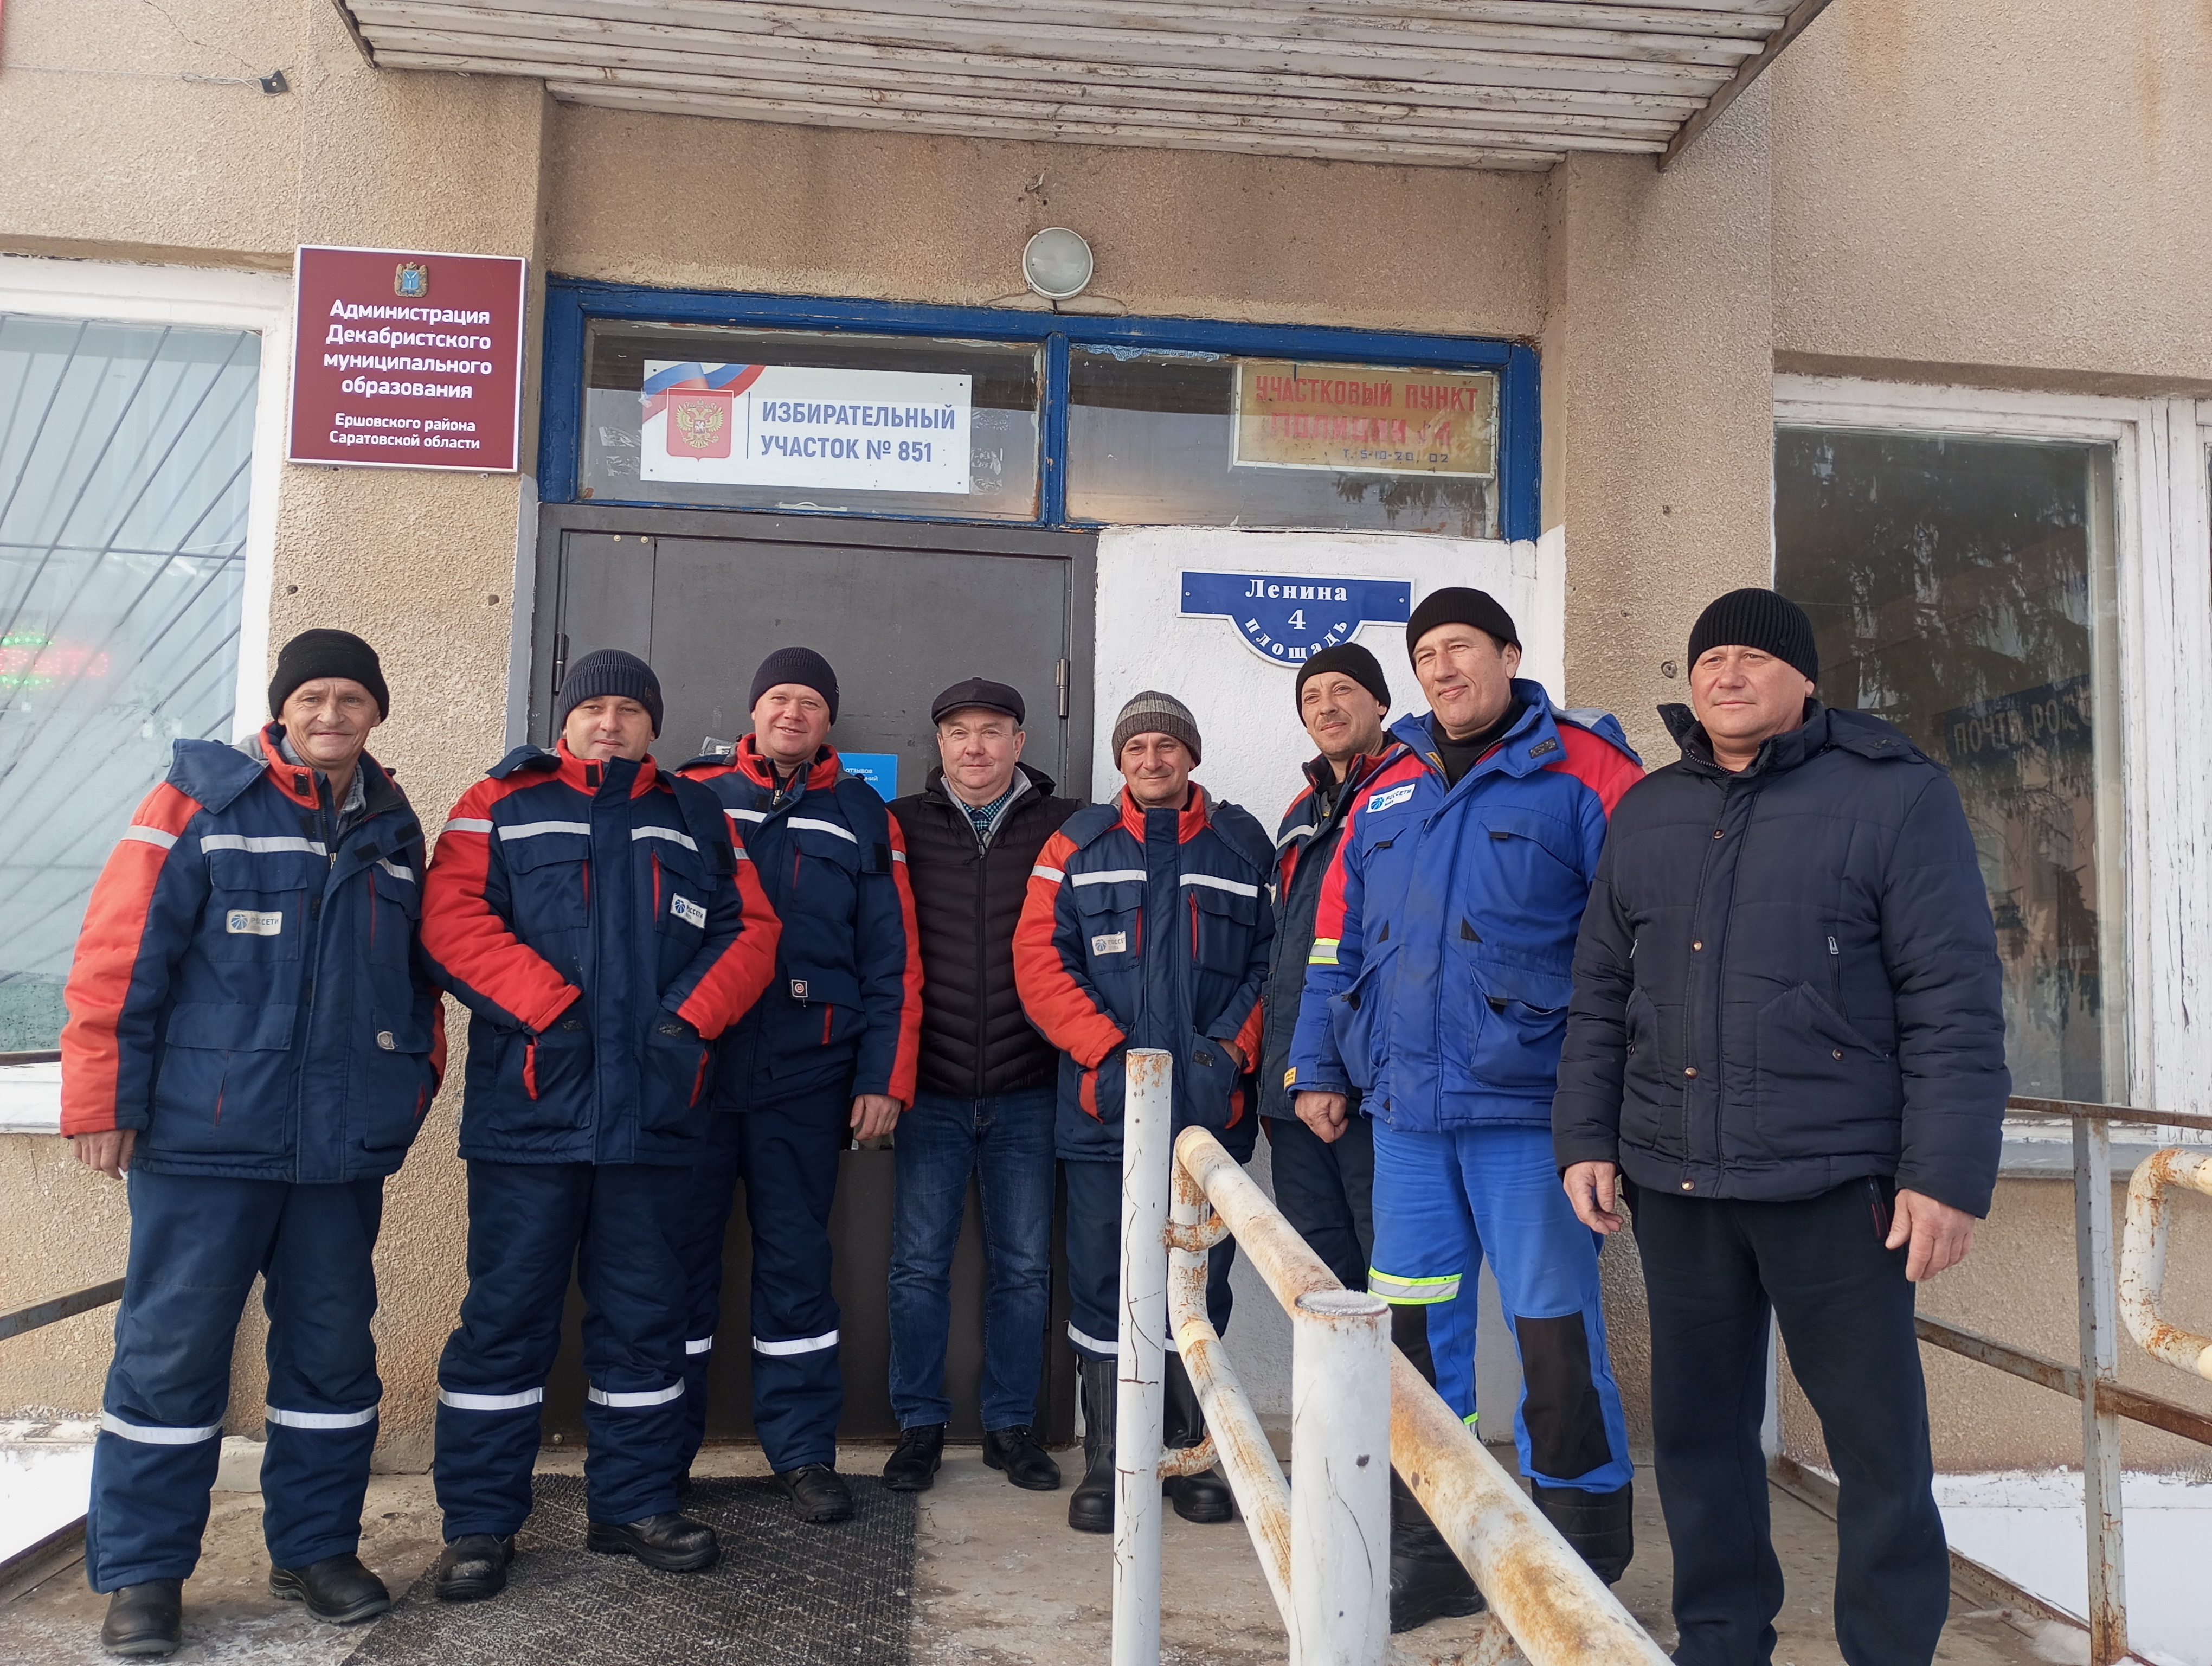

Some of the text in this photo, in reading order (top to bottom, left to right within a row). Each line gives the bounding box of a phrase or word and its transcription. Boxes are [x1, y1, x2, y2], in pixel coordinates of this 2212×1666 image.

[330, 299, 490, 325] Администрация
[326, 324, 491, 349] Декабристского
[324, 354, 492, 374] муниципального
[342, 376, 473, 399] образования
[1256, 375, 1478, 411] УЧАСТКОВЫЙ ПУНКТ
[335, 413, 475, 432] Ершовского района
[763, 402, 955, 430] ИЗБИРАТЕЛЬНЫЙ
[1271, 412, 1406, 443] ПОЛИЦИИ
[329, 431, 480, 450] Саратовской области
[761, 435, 931, 462] УЧАСТОК № 851
[1245, 579, 1348, 602] Ленина
[1288, 609, 1306, 630] 4
[1245, 618, 1348, 661] площадь
[251, 917, 279, 925] РОСЕТИ
